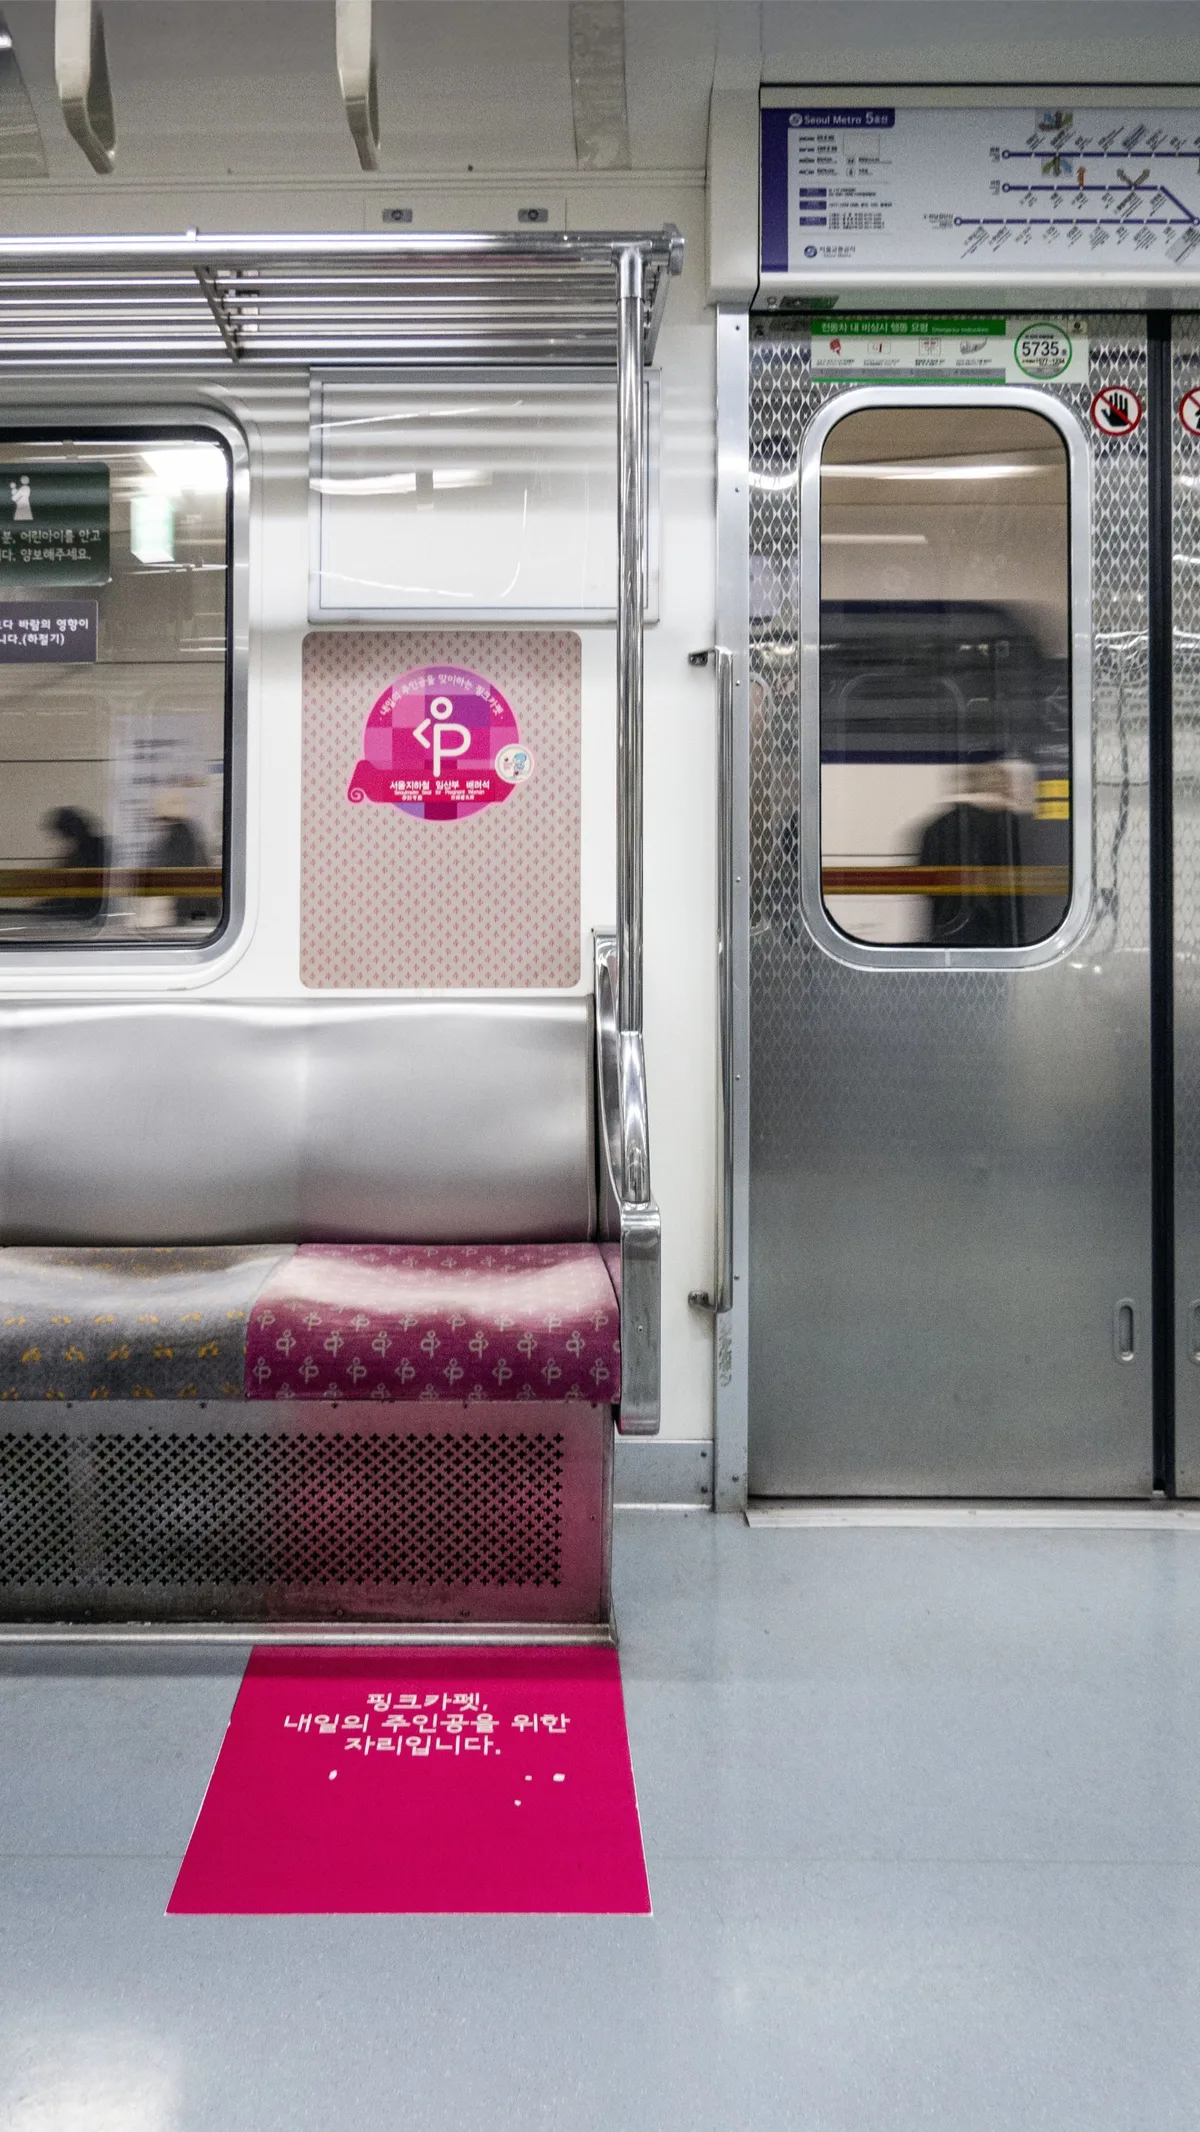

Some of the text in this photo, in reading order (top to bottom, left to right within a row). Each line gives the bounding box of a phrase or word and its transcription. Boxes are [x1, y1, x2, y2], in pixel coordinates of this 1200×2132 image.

[804, 115, 830, 125] Seoul
[832, 115, 862, 125] Metro
[20, 529, 75, 544] 어린아이를
[79, 528, 101, 544] 안고
[0, 547, 91, 563] 다. 양보해주세요.
[18, 618, 51, 632] 바람의
[56, 617, 89, 632] 영향이
[389, 780, 490, 790] 서울지하철 임산부 배려석
[366, 1692, 489, 1712] 핑크카펫,
[283, 1712, 571, 1734] 내일의 주인공을 위한
[344, 1734, 501, 1757] 자리입니다.
